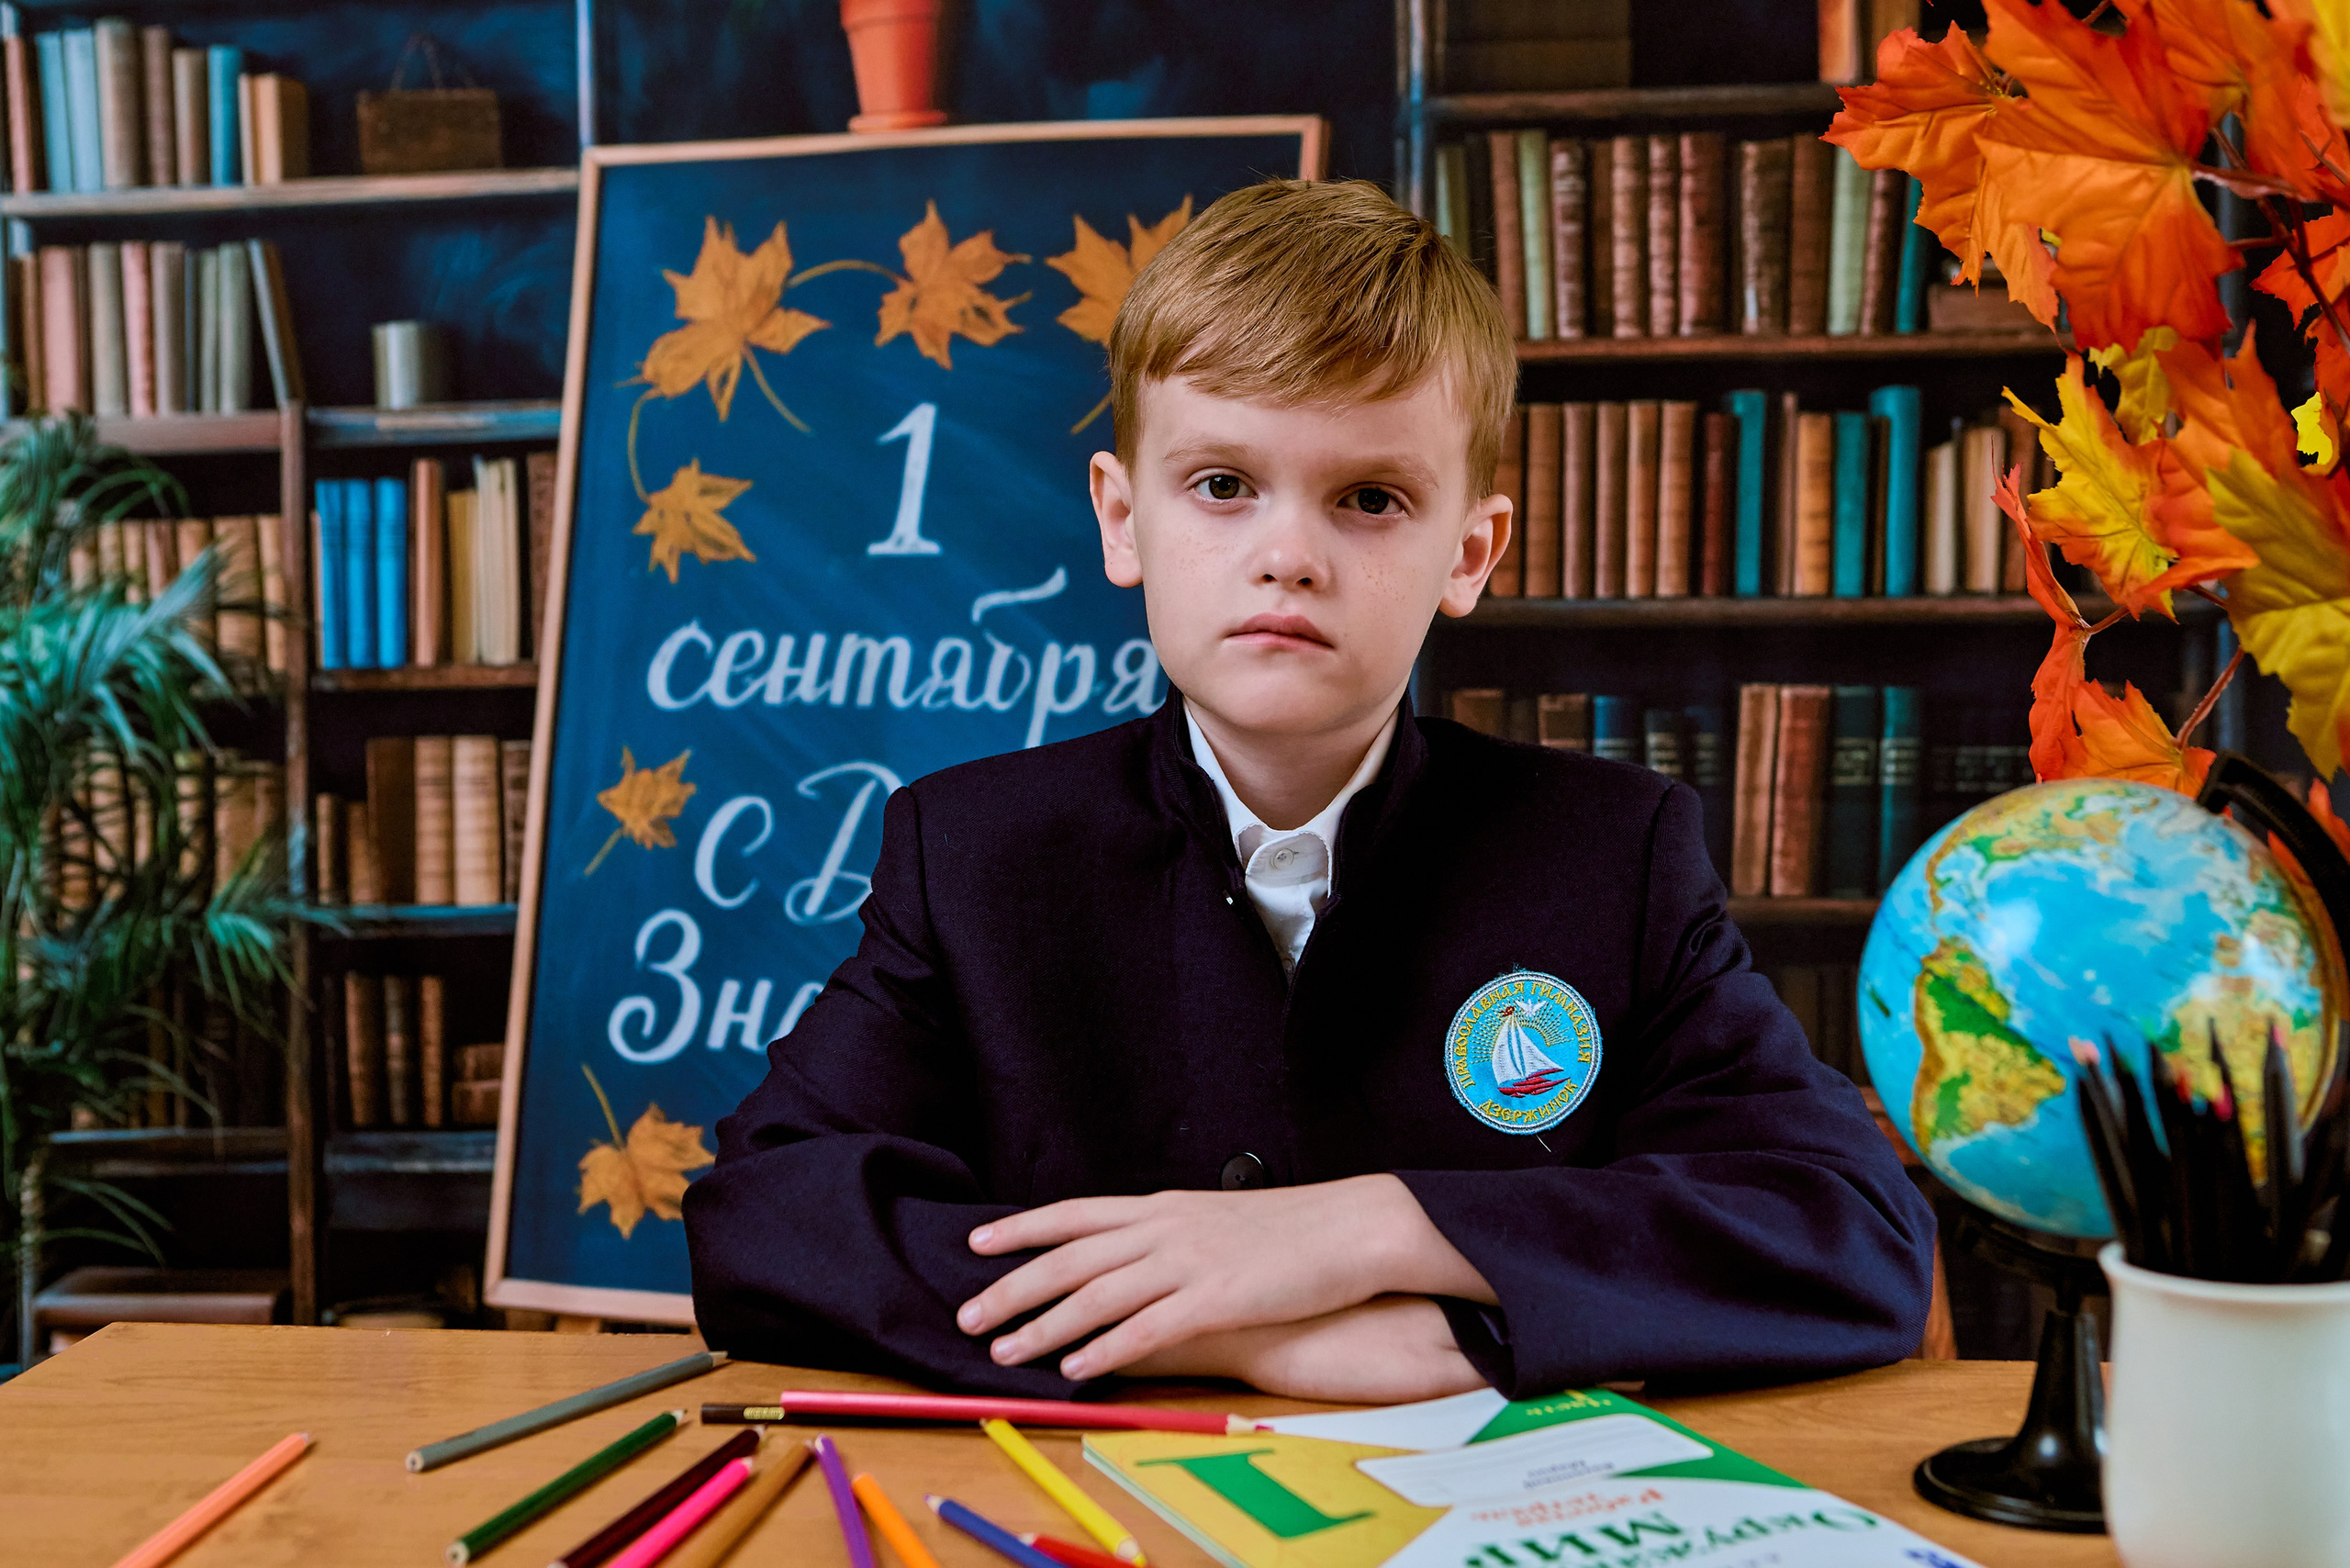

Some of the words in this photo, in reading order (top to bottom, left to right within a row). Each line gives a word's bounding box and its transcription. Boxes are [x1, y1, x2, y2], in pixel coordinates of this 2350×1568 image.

[867, 402, 943, 555] 1
[646, 566, 1167, 750] сентября
[1454, 981, 1525, 1090] ПРАВОСЛАВНАЯ
[1530, 981, 1592, 1064] ГИМНАЗИЯ
